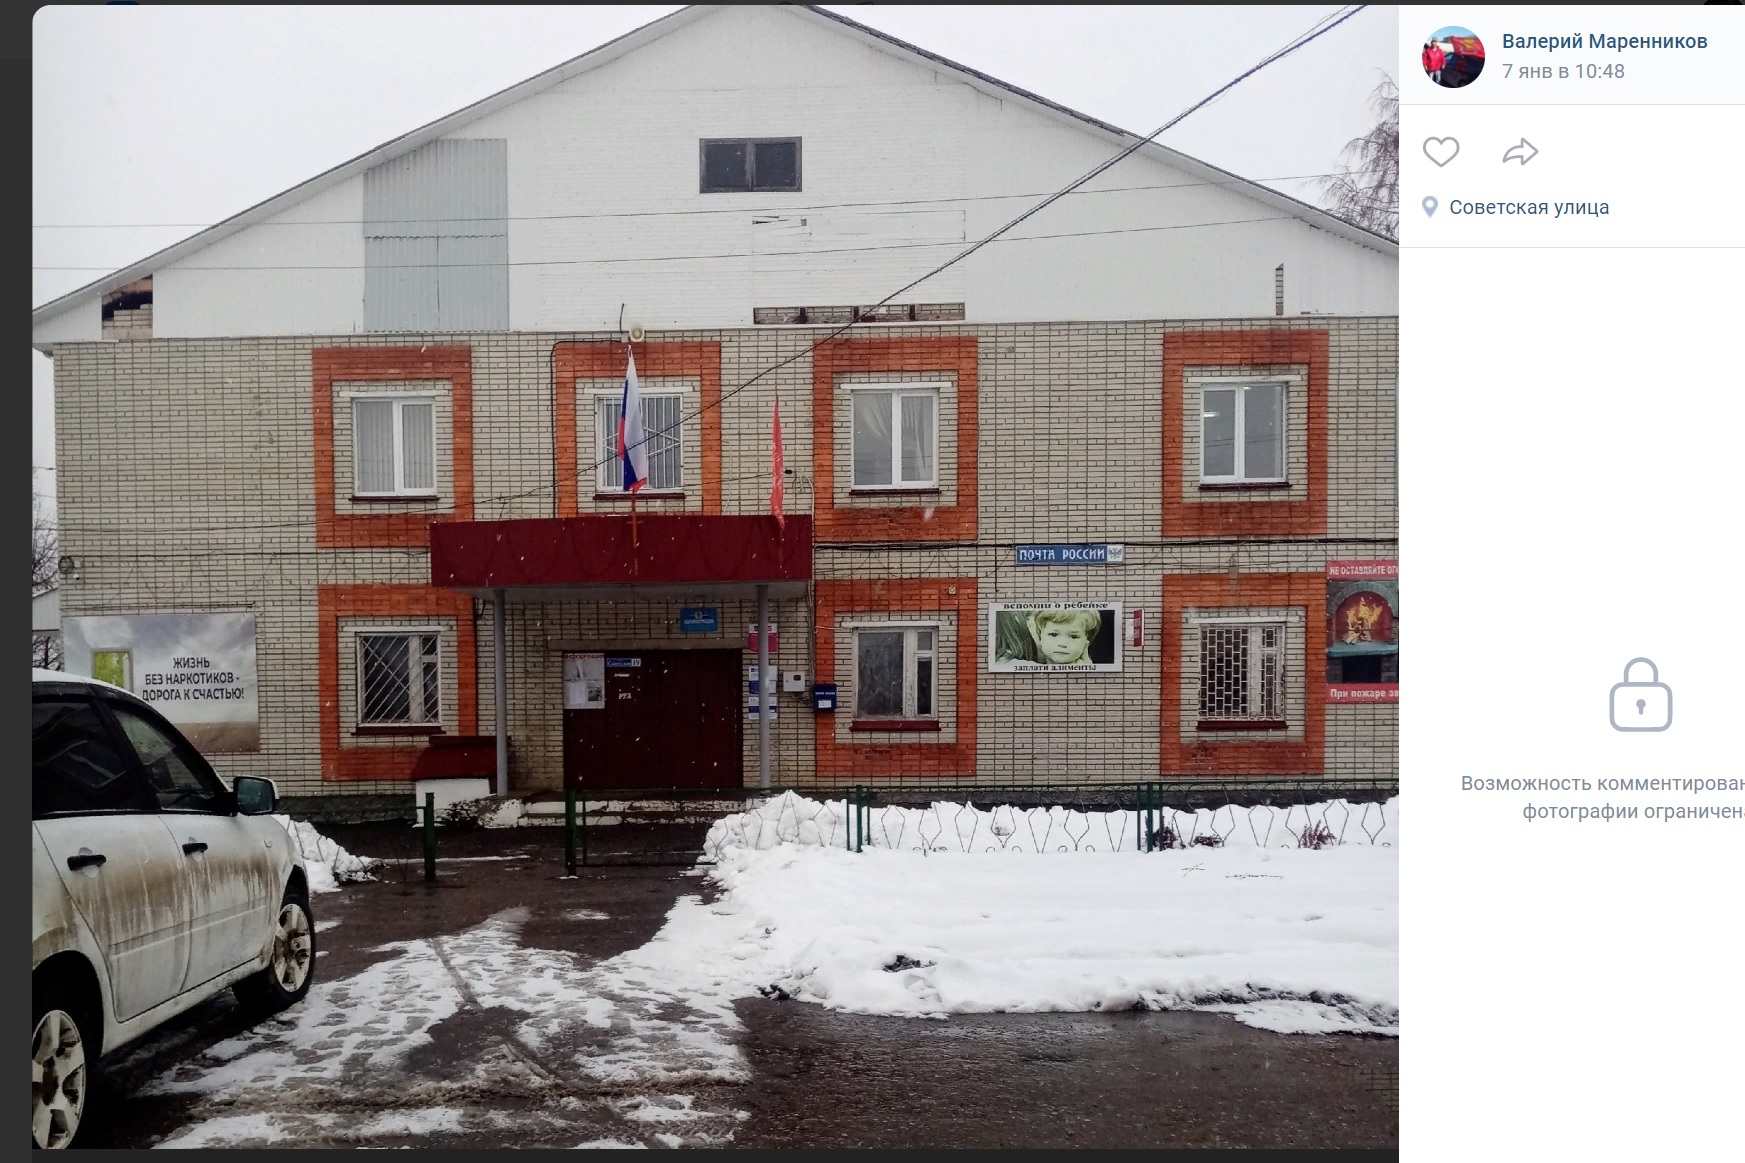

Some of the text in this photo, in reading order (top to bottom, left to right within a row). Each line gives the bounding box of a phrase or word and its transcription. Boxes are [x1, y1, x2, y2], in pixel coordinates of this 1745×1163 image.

[1019, 548, 1105, 561] ПОЧТА РОССИИ
[1330, 566, 1340, 575] НЕ
[173, 657, 210, 669] ЖИЗНЬ
[145, 674, 163, 685] БЕЗ
[165, 672, 234, 684] НАРКОТИКОВ
[142, 687, 245, 701] ДОРОГА К СЧАСТЬЮ!
[1330, 688, 1349, 699] При
[1351, 690, 1386, 699] пожаре
